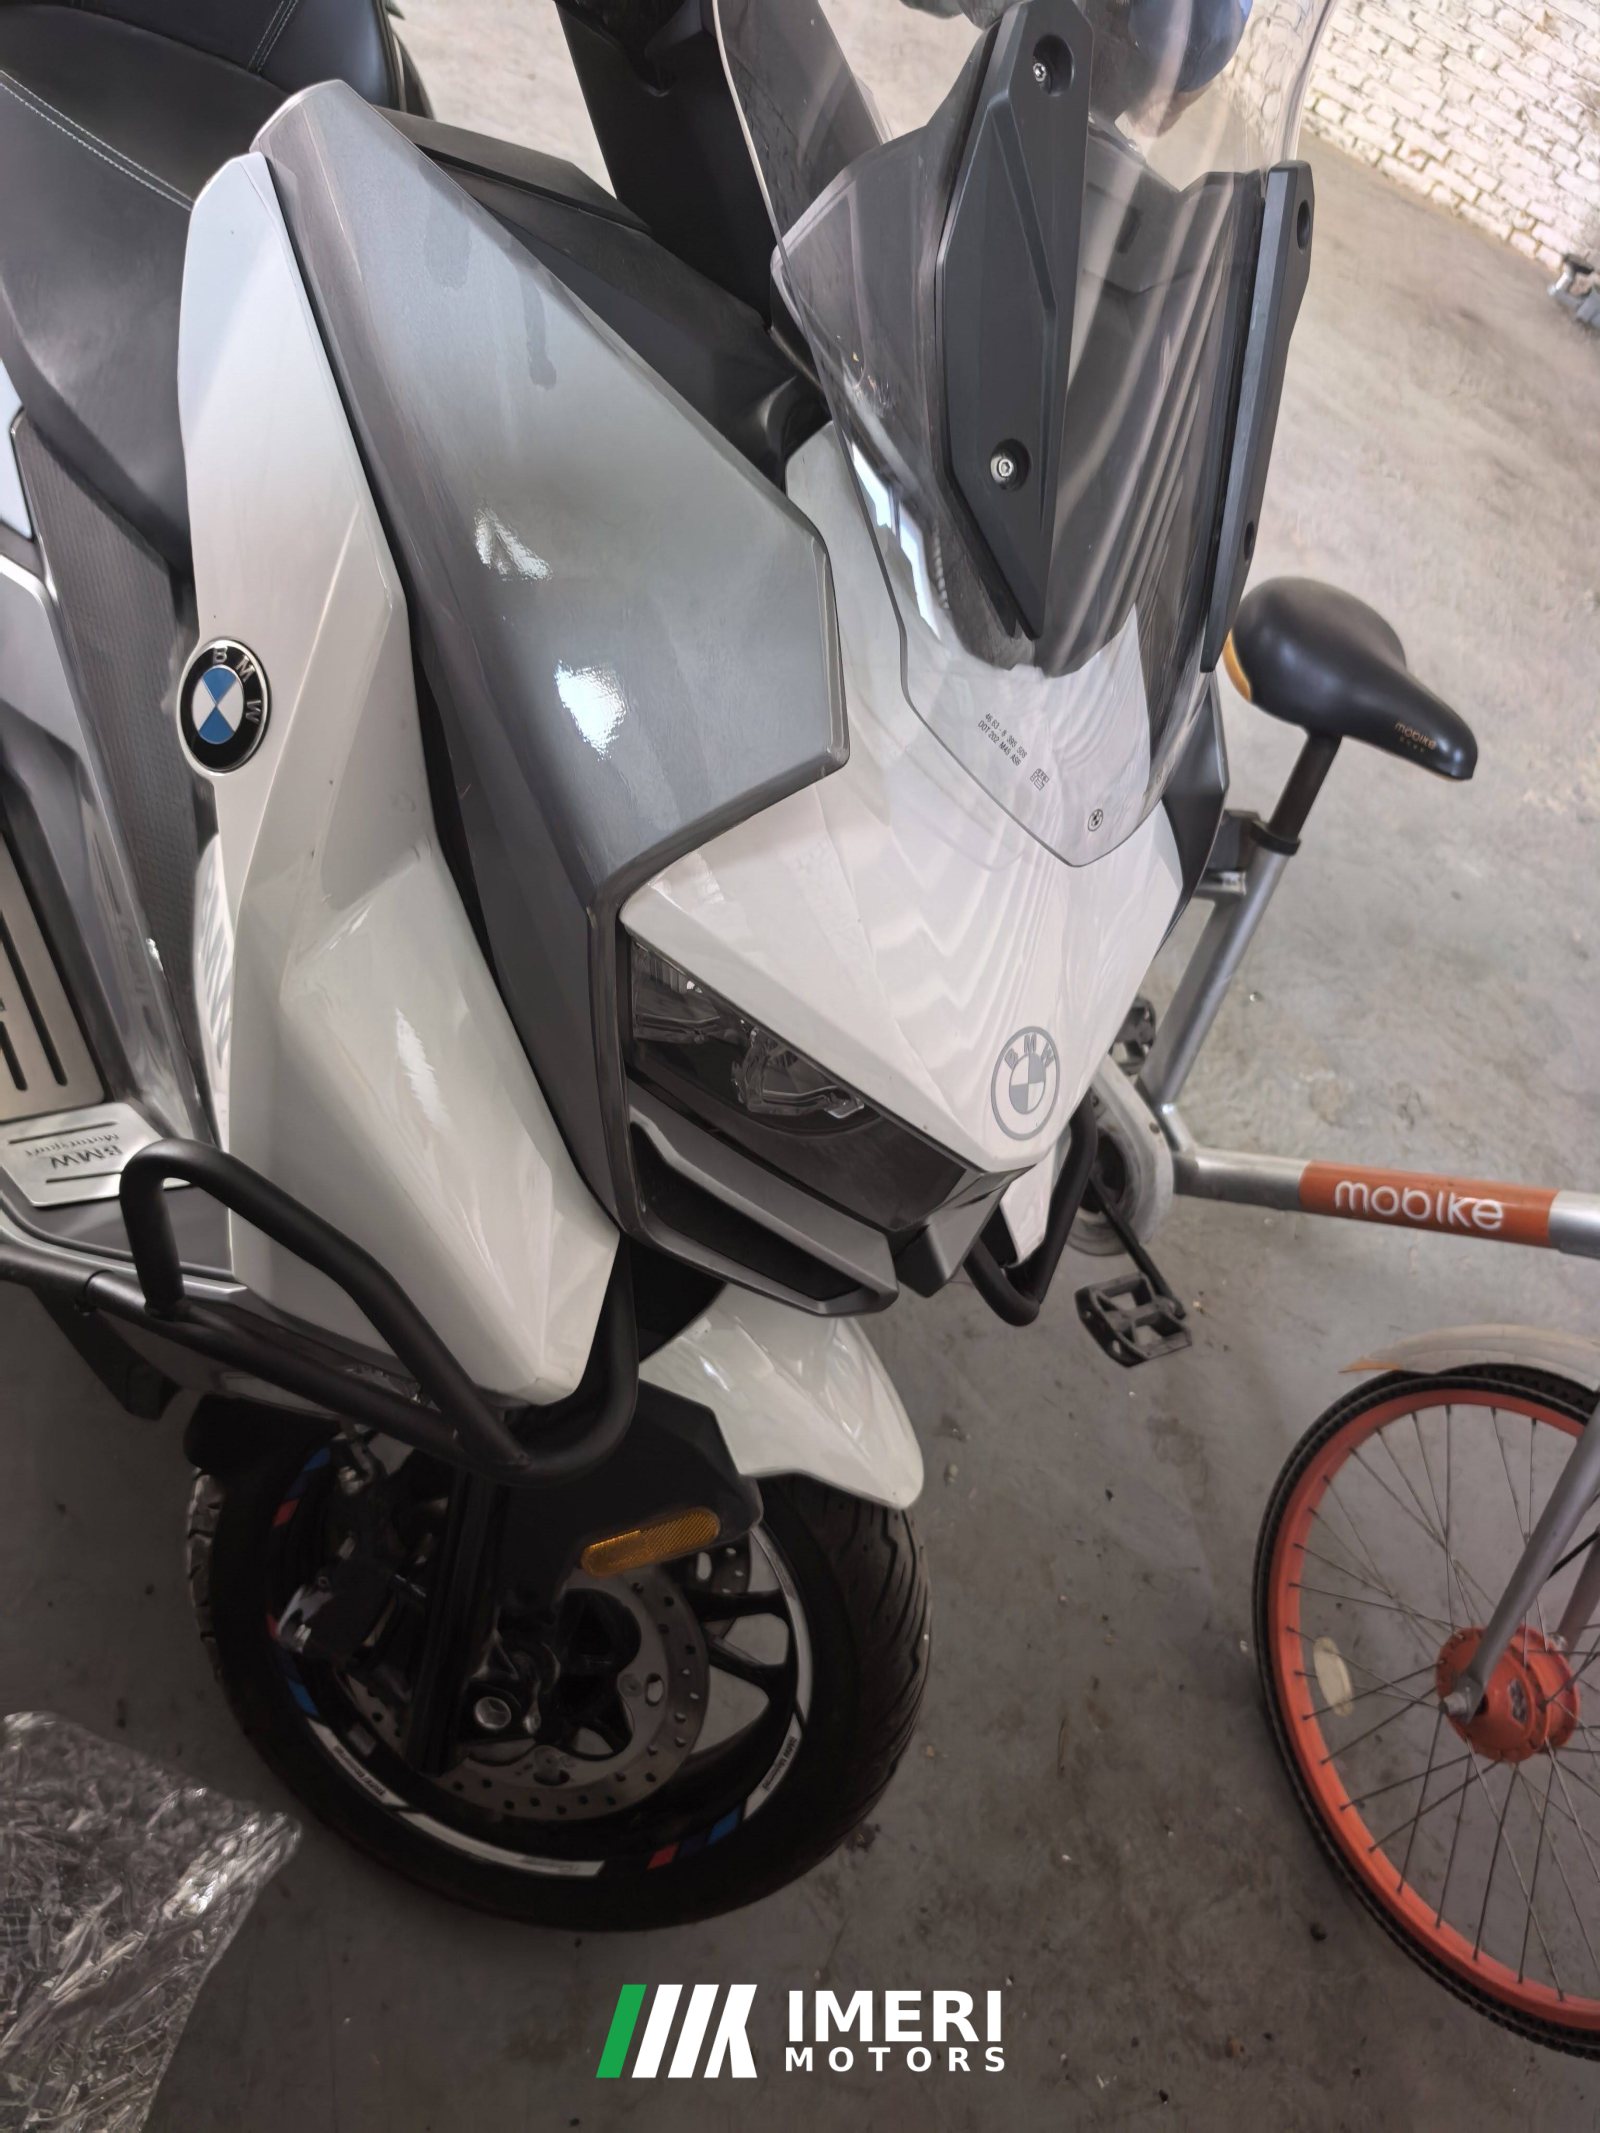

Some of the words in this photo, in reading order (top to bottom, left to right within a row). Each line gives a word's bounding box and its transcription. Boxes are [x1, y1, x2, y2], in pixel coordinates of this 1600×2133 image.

[212, 647, 262, 724] BMW
[977, 720, 991, 734] DOT
[1004, 1031, 1056, 1070] BMW
[50, 1144, 123, 1170] BMW
[1334, 1180, 1504, 1229] mobike
